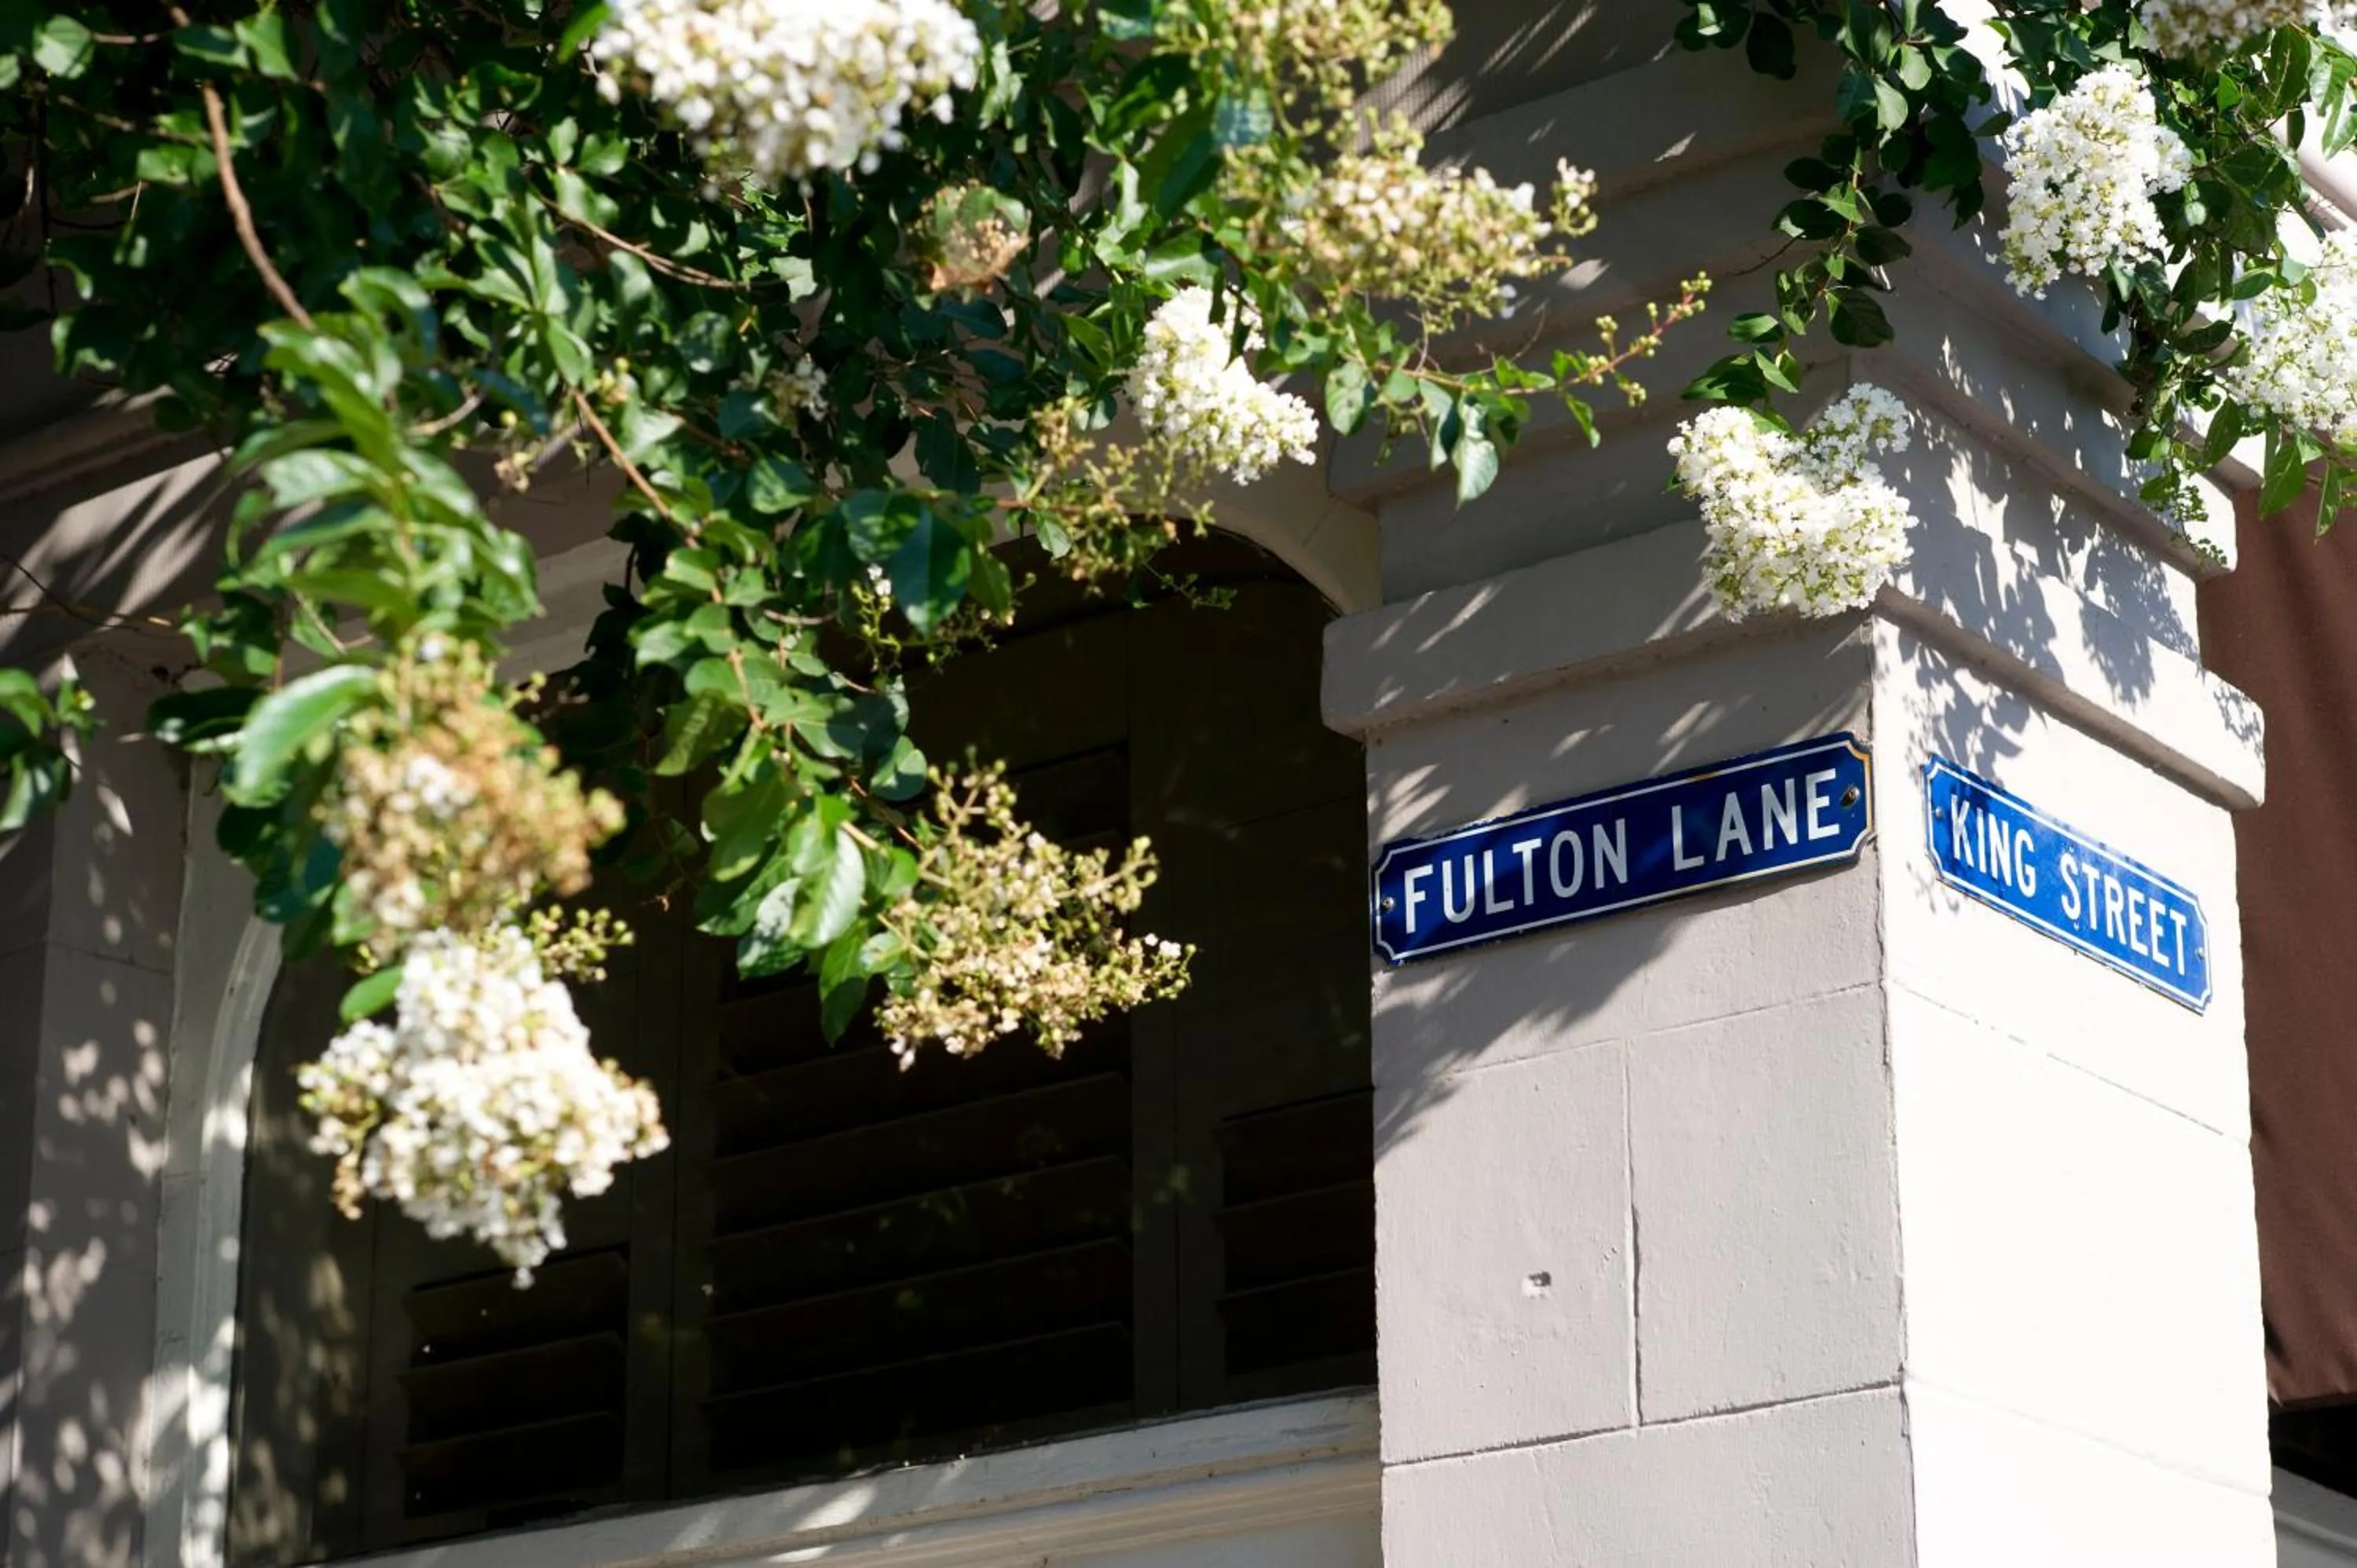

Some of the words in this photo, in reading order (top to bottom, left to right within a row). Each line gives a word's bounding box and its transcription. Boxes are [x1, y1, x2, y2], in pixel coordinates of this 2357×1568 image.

[1403, 818, 1628, 933] FULTON
[1671, 768, 1841, 871] LANE
[1951, 793, 2036, 898] KING
[2059, 852, 2187, 976] STREET
